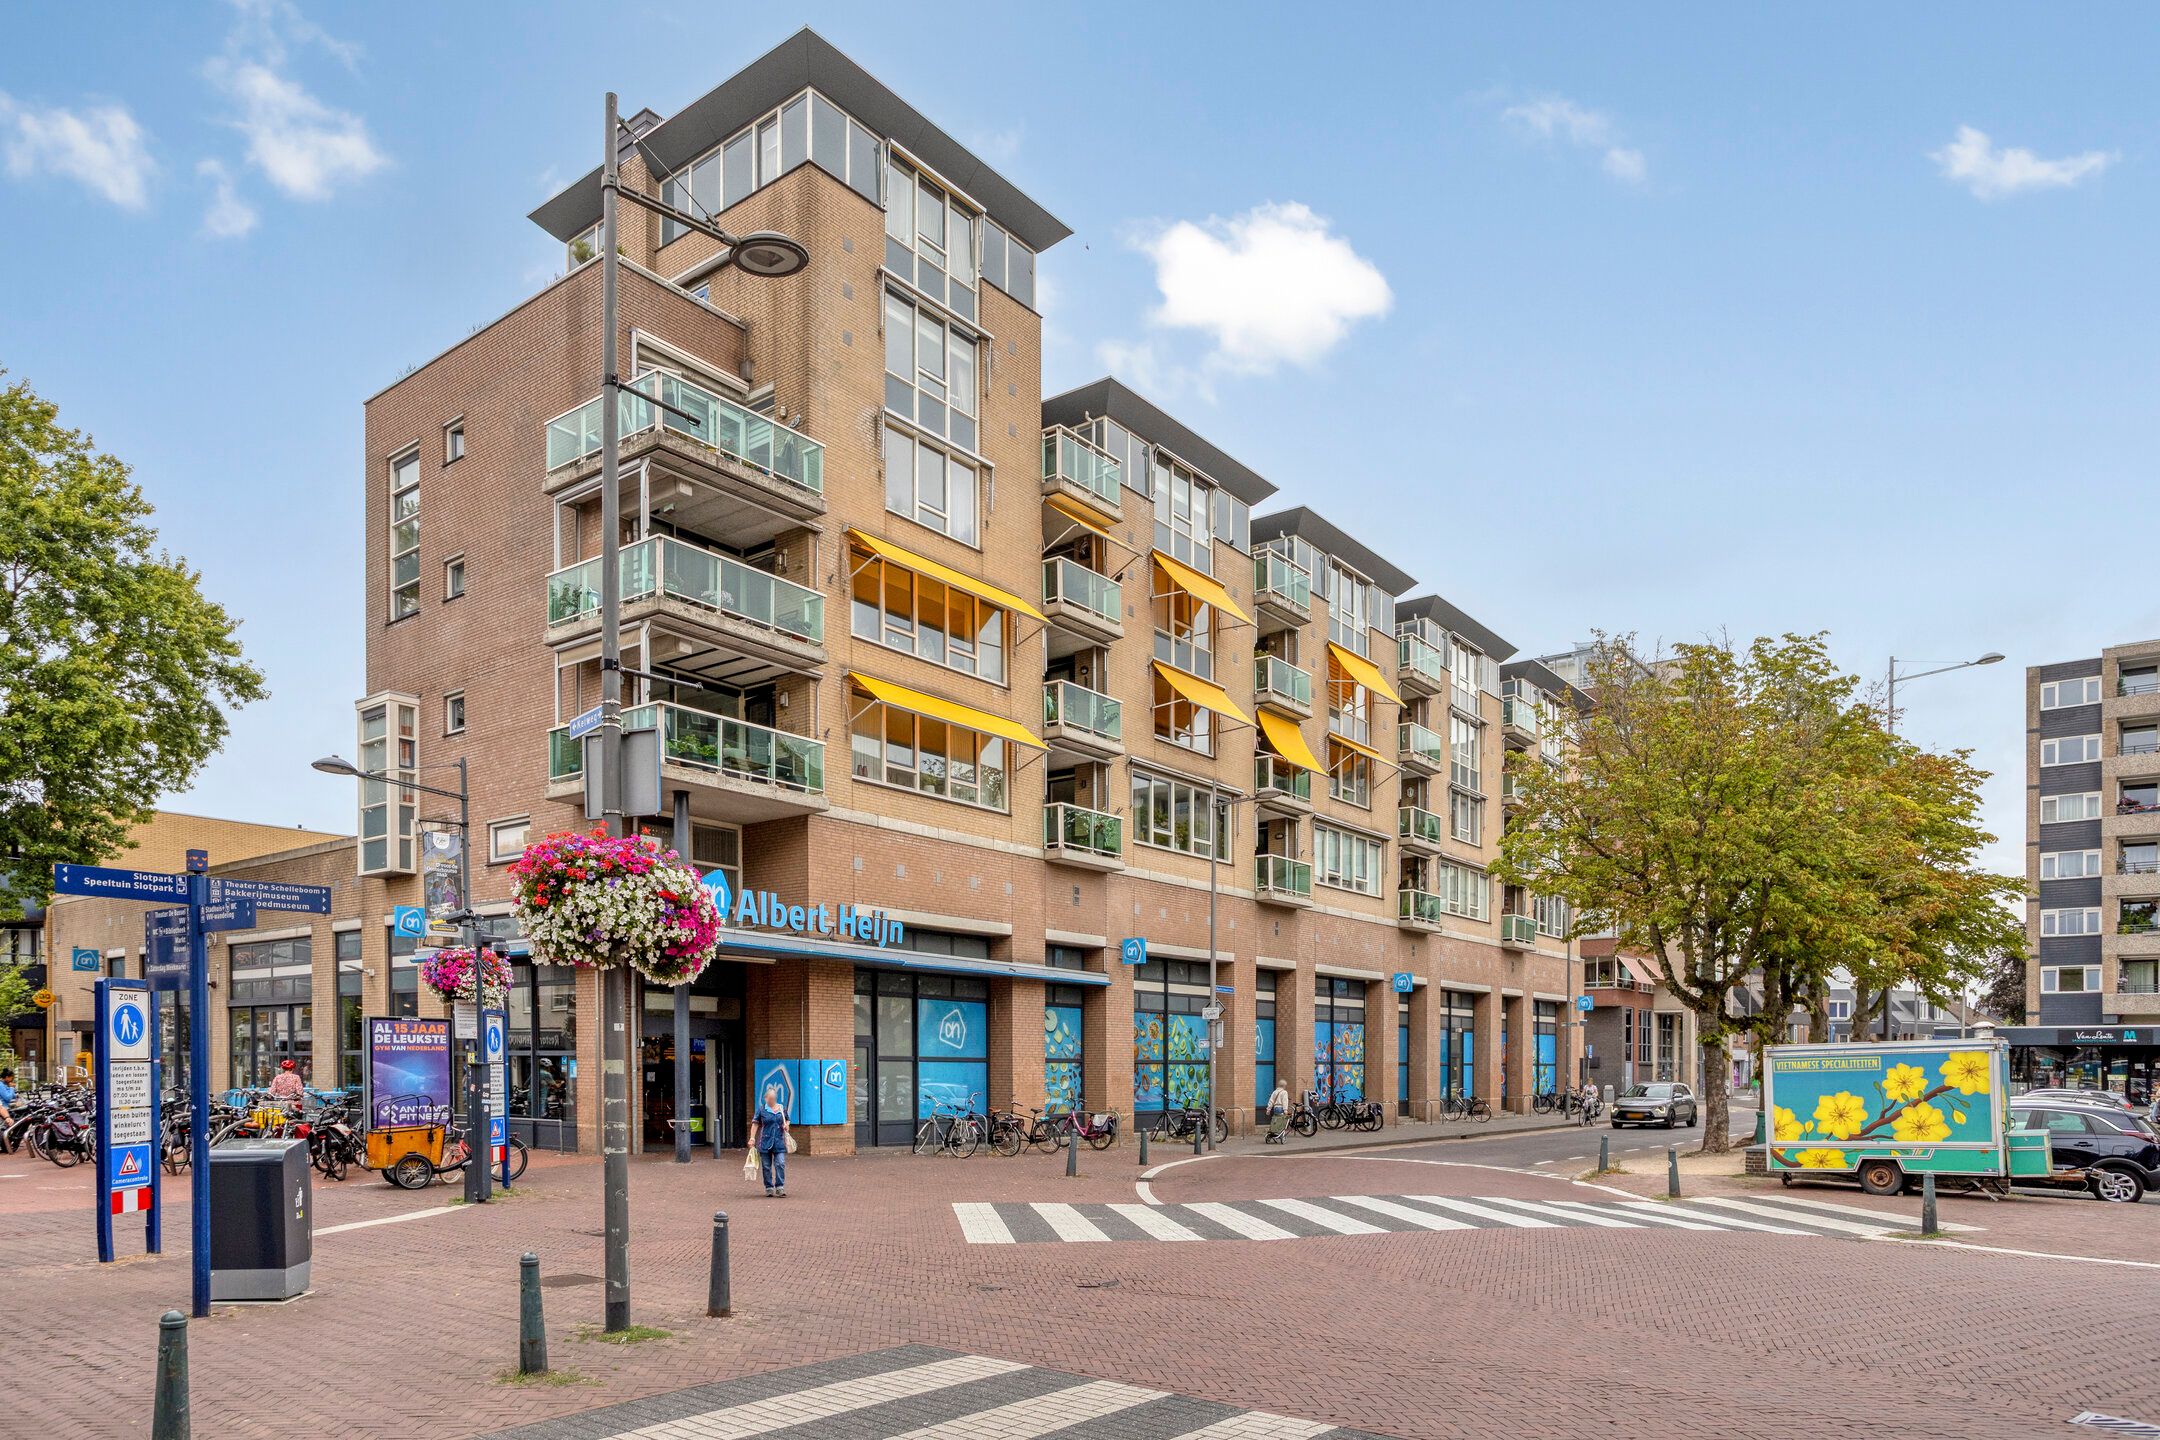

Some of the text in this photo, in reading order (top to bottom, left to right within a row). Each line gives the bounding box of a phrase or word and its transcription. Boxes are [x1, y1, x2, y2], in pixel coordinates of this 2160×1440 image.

[134, 873, 173, 883] Slotpark
[84, 878, 174, 892] Speeltuin Slotpark
[225, 881, 256, 889] Theater
[271, 884, 320, 894] Schelleboom
[225, 888, 300, 901] Bakkerijmuseum
[736, 890, 904, 948] Albert Heijn
[374, 1023, 446, 1034] AL 15 JAAR
[374, 1034, 446, 1044] DE LEUKSTE
[1776, 1059, 1878, 1070] VIETNAMESE SPECIALITEITEN
